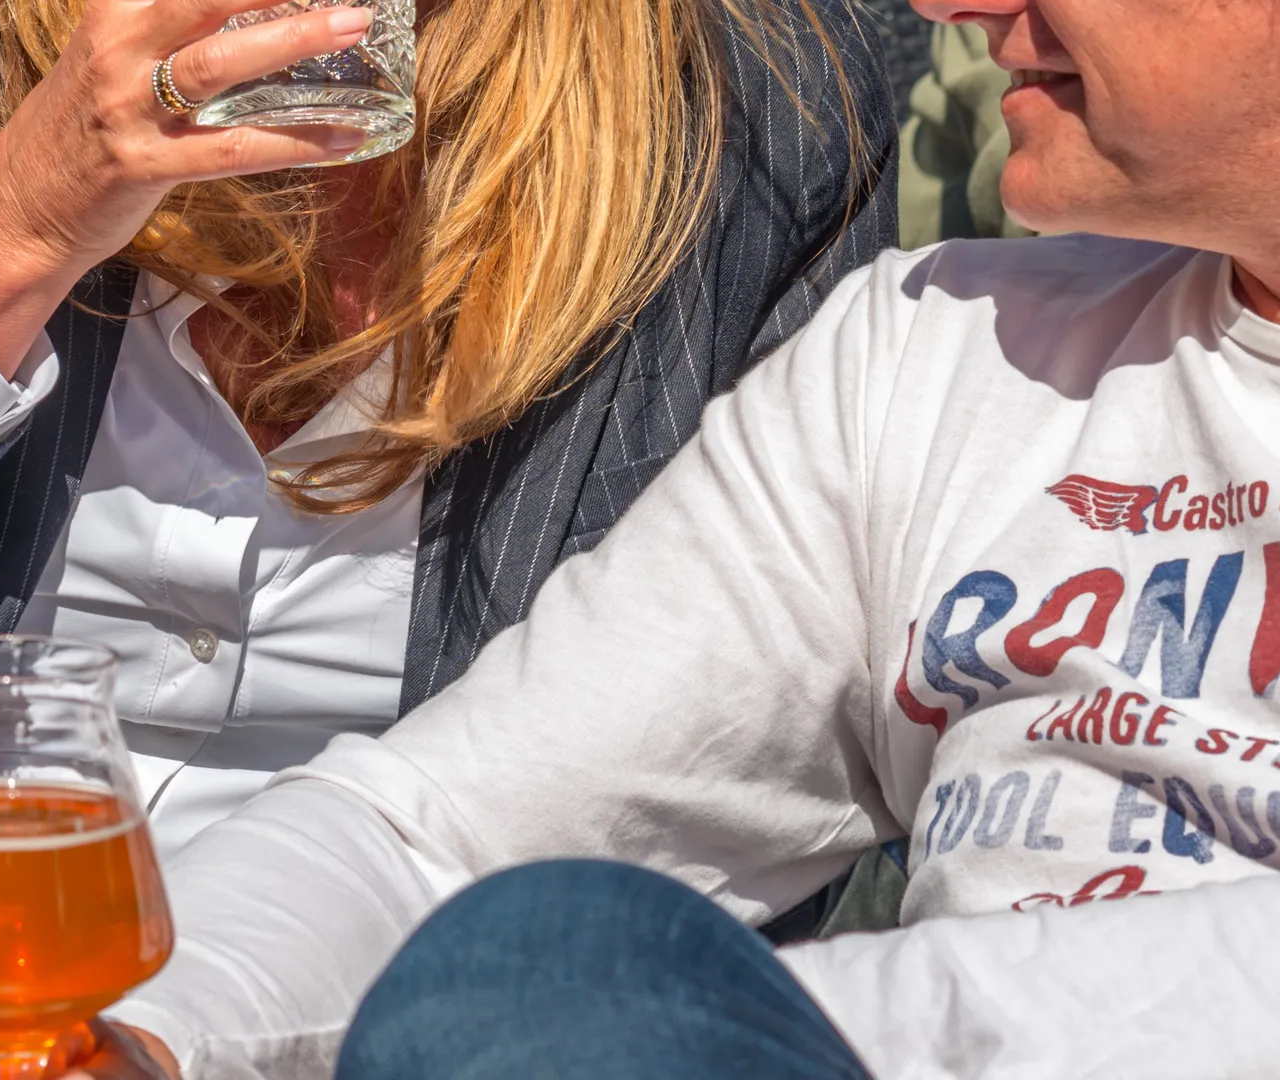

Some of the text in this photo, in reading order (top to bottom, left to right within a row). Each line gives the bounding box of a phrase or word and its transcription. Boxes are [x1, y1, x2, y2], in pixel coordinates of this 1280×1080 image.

[1152, 473, 1269, 532] Castro
[1025, 686, 1185, 746] LARGE
[924, 769, 1064, 862] TOOL
